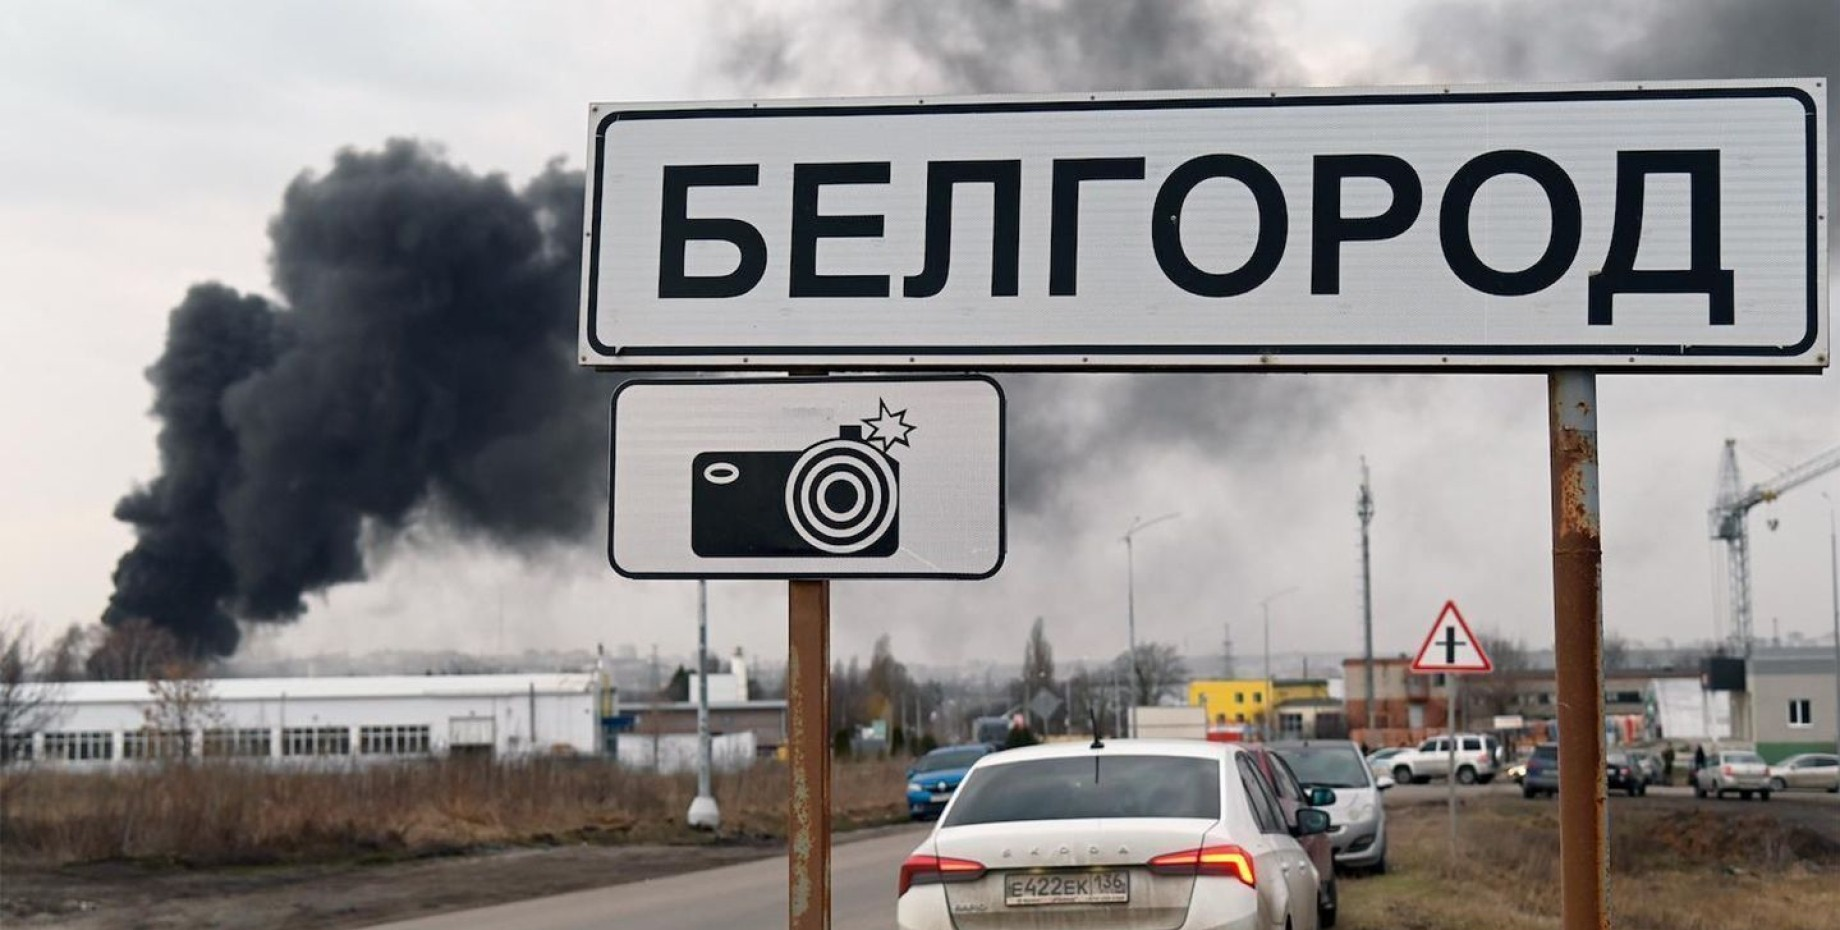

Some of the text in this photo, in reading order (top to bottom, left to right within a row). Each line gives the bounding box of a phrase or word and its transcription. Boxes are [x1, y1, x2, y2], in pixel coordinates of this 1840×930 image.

[658, 149, 1735, 326] БЕЛГОРОД
[1011, 873, 1122, 897] Е422ЕК 136
